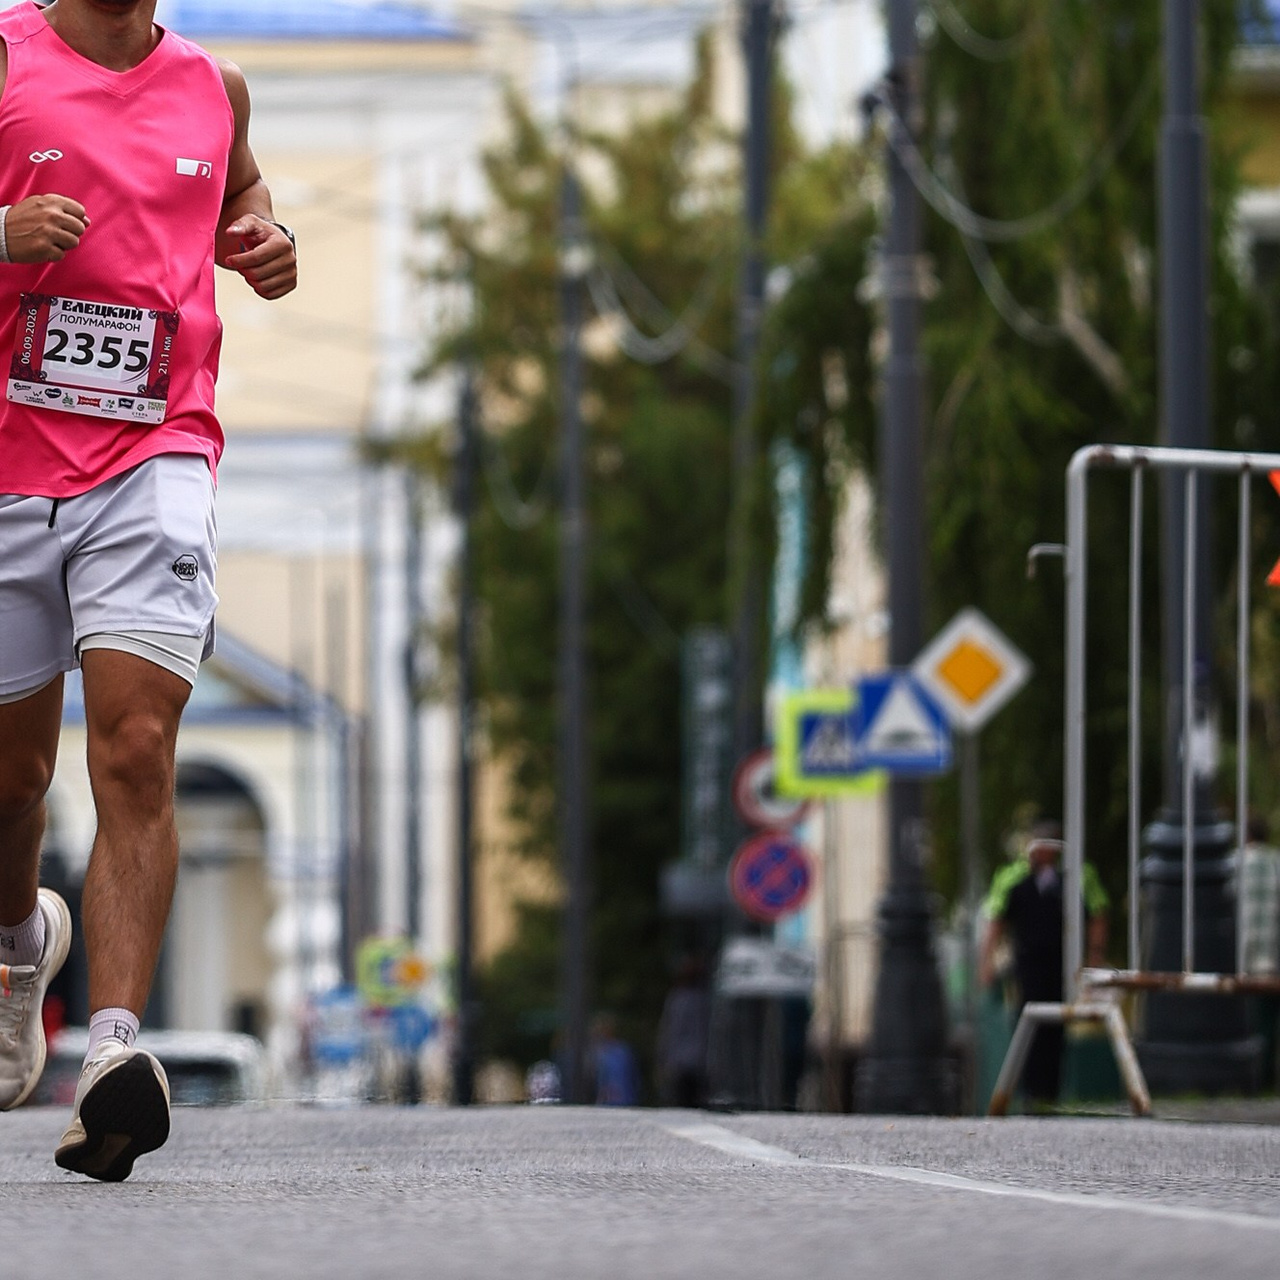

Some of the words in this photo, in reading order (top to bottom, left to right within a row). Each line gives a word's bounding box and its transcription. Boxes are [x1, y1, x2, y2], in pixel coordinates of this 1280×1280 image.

[62, 300, 143, 321] ЕЛЕЦКИЙ
[59, 314, 141, 333] ПОЛУМАРАФОН
[21, 308, 37, 364] 06.09.2026
[43, 329, 150, 372] 2355
[158, 353, 170, 375] 21,1
